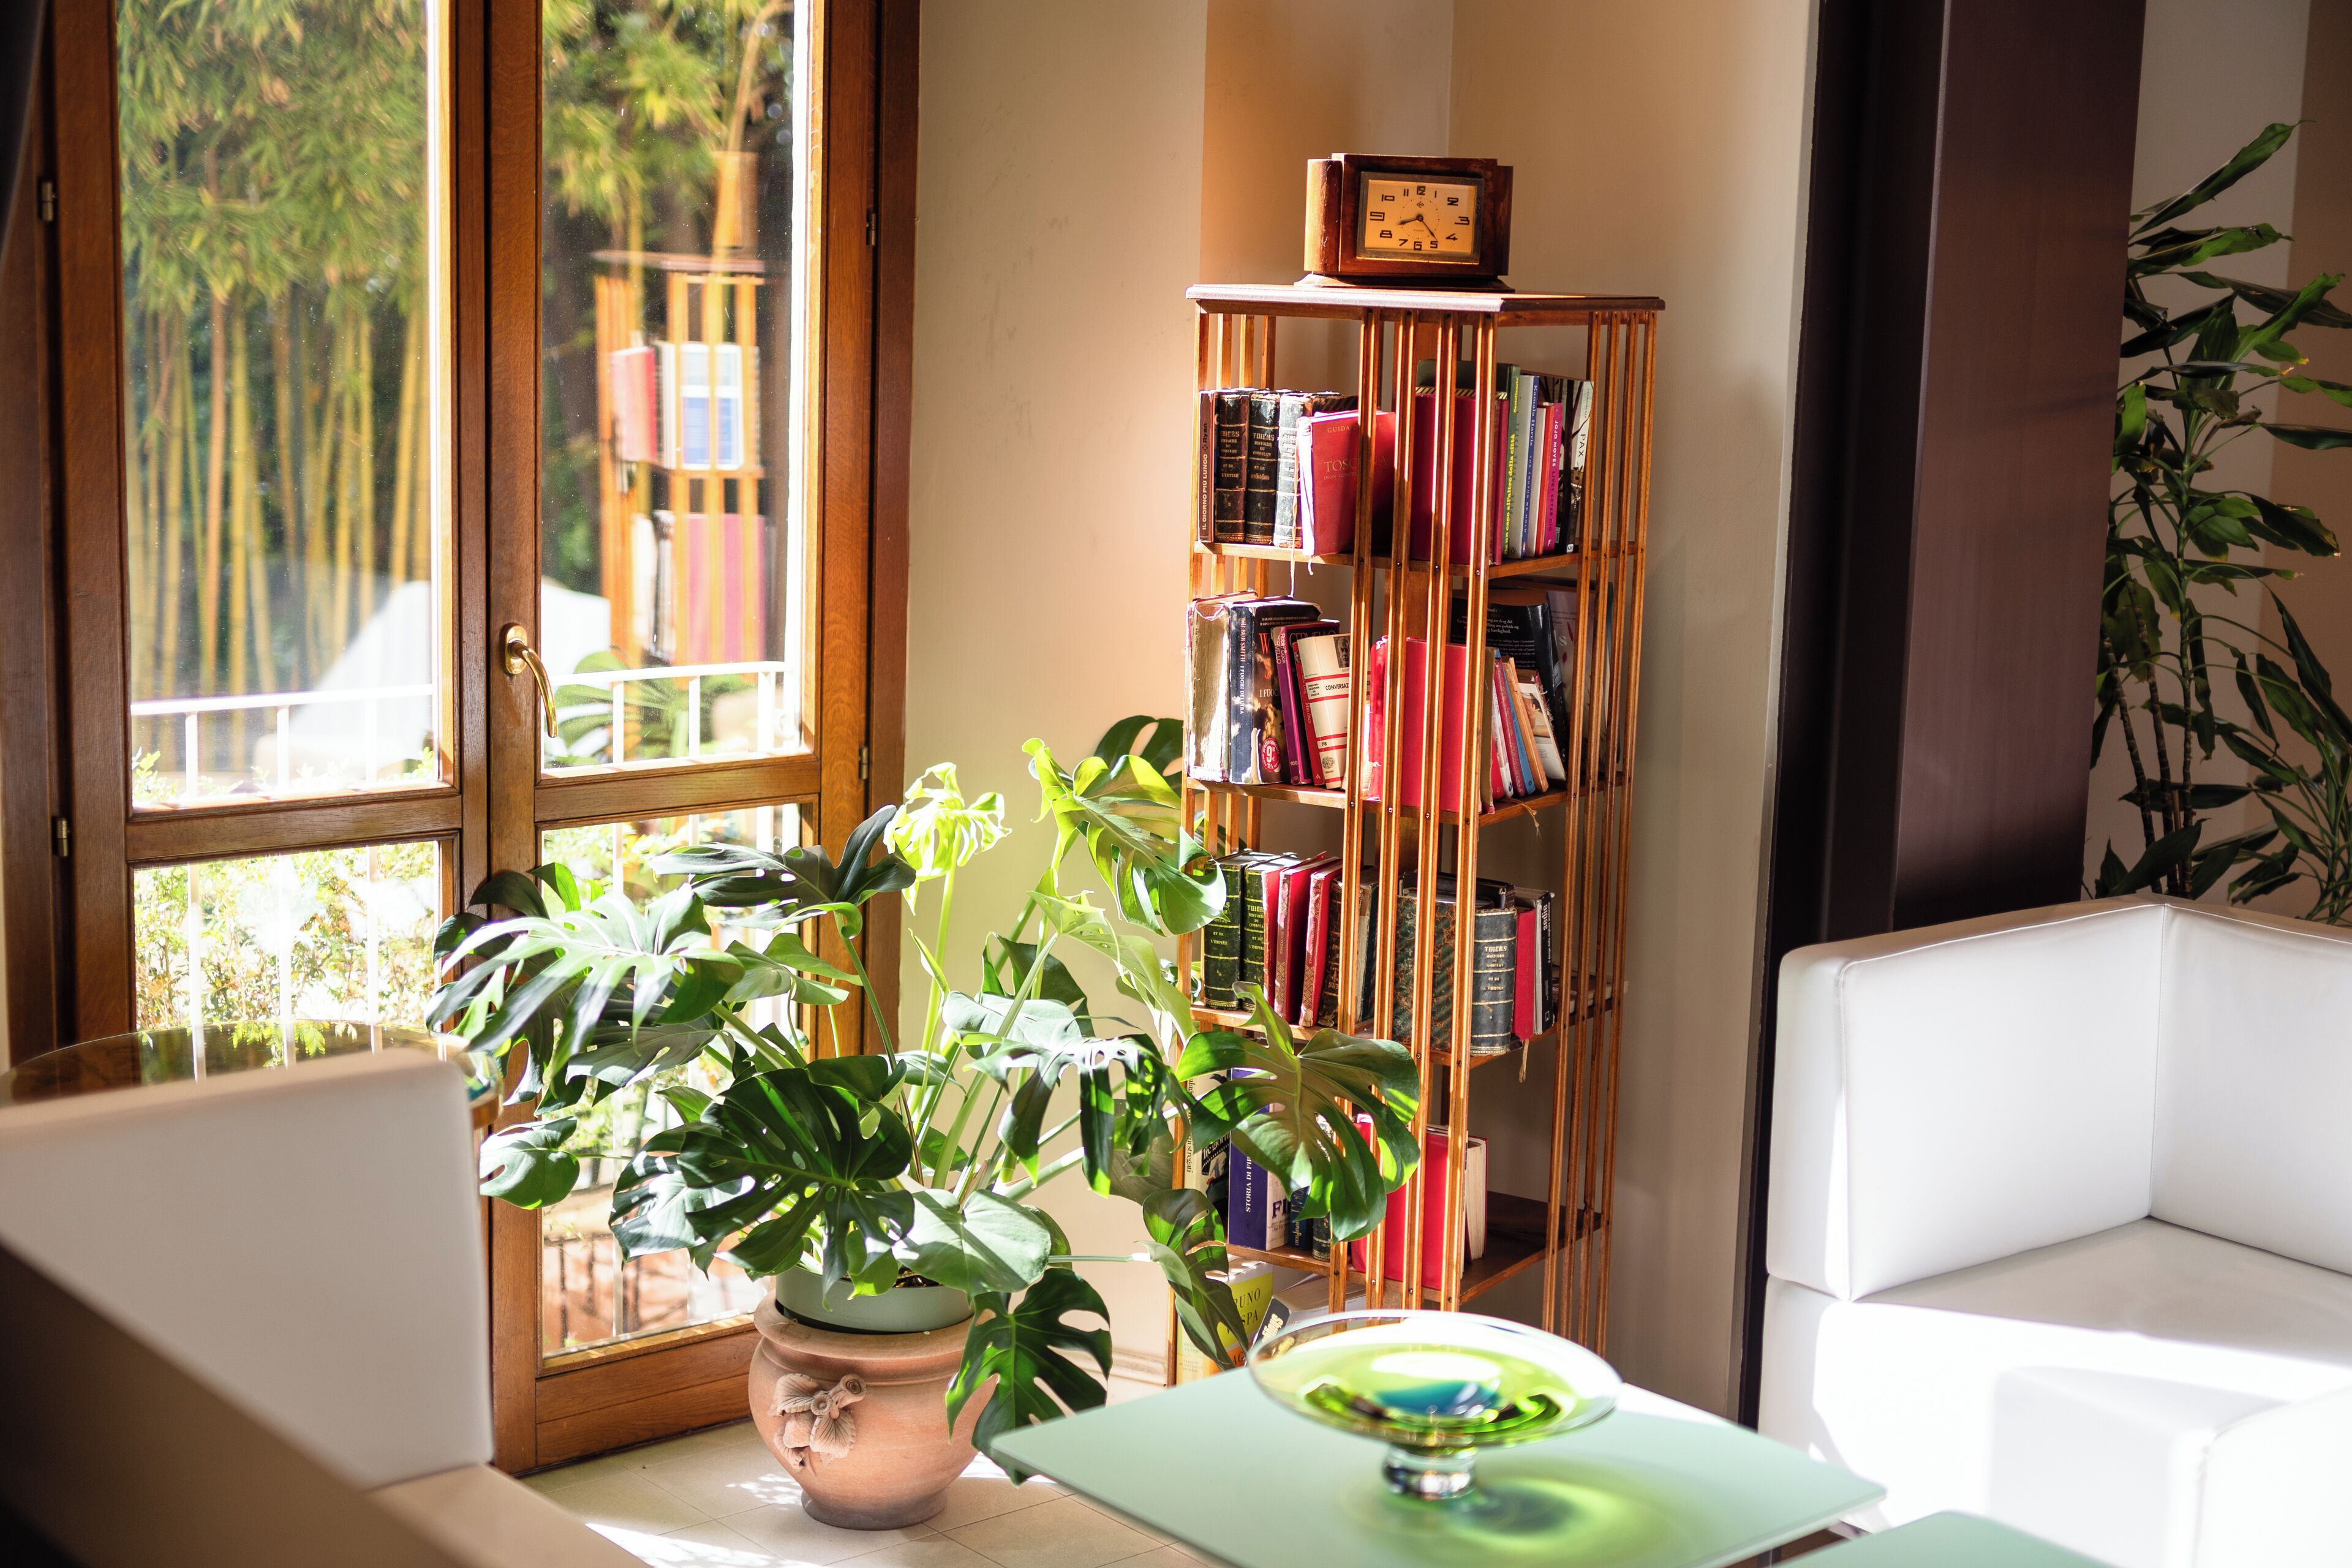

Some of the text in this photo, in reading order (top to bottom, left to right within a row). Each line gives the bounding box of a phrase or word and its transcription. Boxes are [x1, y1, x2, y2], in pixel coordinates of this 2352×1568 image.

[1447, 197, 1458, 206] 2
[1455, 216, 1469, 225] 3
[1380, 230, 1392, 238] 8
[1414, 241, 1422, 250] 6
[1324, 456, 1387, 472] TOSCA
[1266, 745, 1272, 763] 9
[1246, 1172, 1251, 1180] DI
[1234, 1287, 1261, 1308] RUNO
